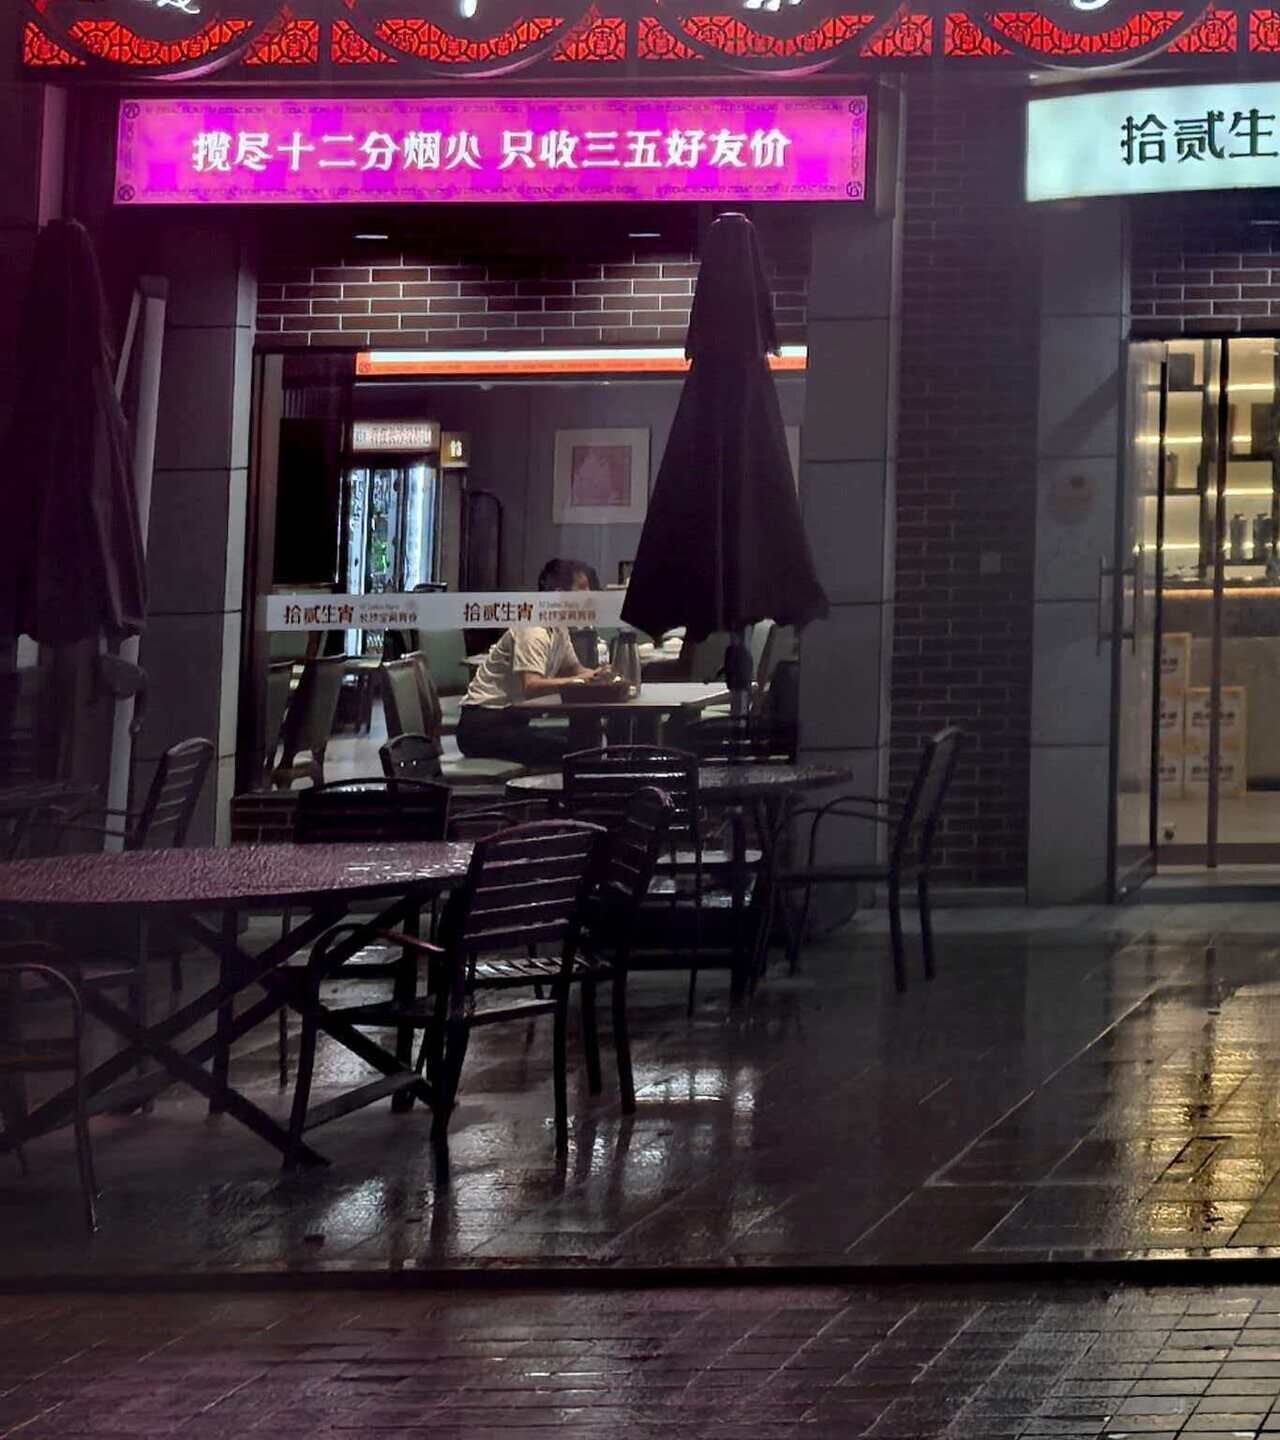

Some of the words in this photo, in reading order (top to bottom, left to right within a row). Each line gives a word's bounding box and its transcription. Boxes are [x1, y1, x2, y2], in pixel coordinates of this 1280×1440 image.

[499, 126, 793, 172] 只收三五好友价
